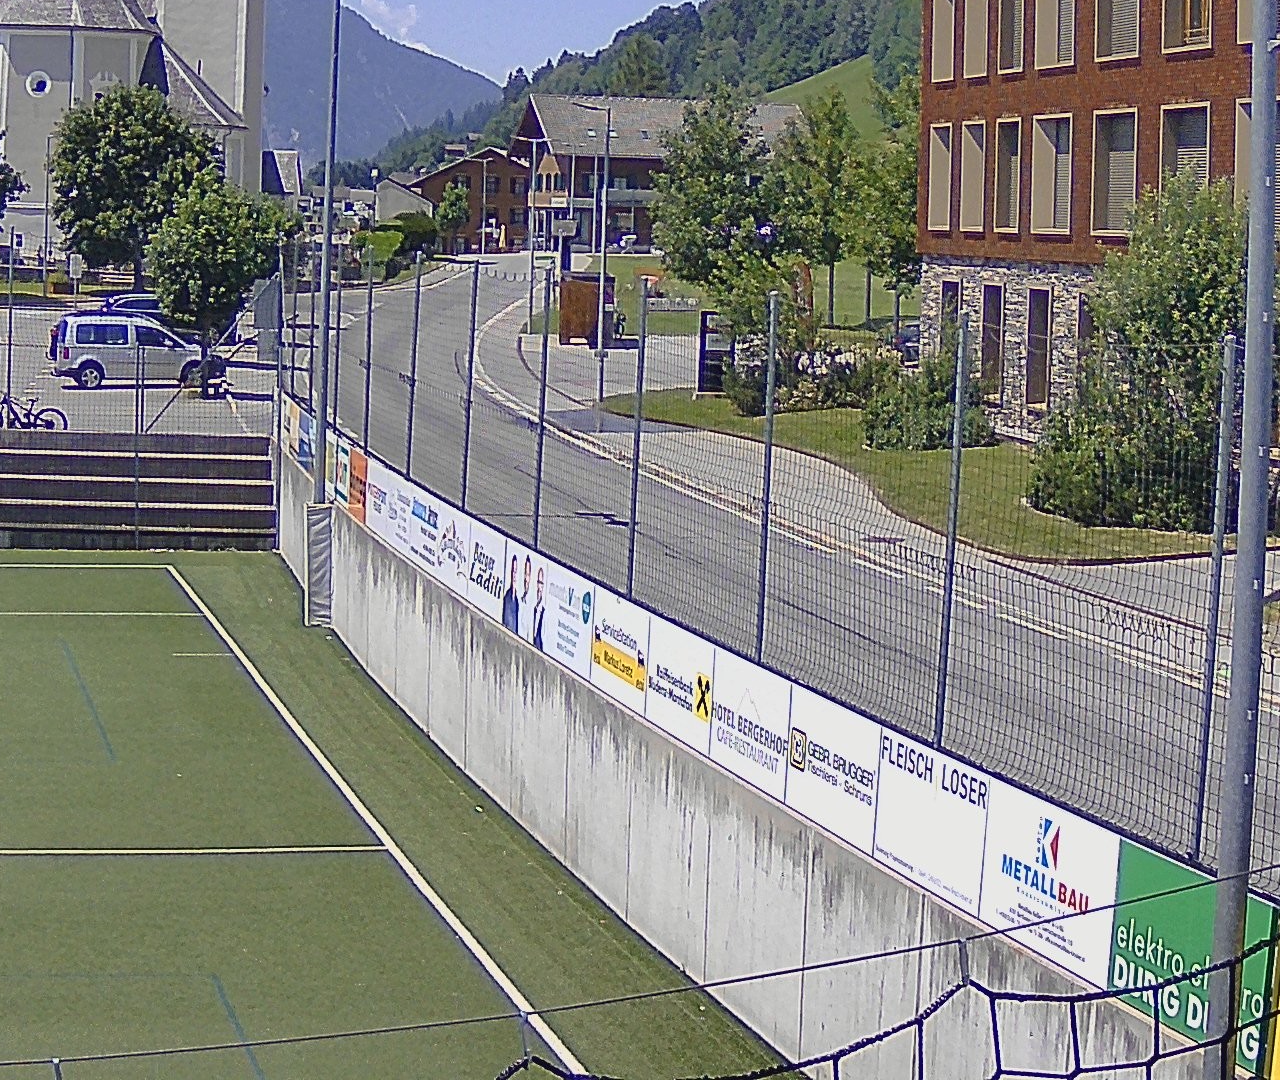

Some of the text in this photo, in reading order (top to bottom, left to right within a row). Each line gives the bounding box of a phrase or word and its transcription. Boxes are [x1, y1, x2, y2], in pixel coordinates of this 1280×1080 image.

[656, 664, 694, 696] Raiffeisenbank
[712, 701, 789, 757] HOTEL BERGERHOF
[807, 759, 838, 786] Tischlerei
[843, 780, 873, 806] Schruns
[832, 753, 874, 790] BRUGGER
[881, 735, 988, 810] FLEISCH LOSER
[1001, 853, 1089, 915] METALLBAU
[1117, 918, 1184, 975] elektro
